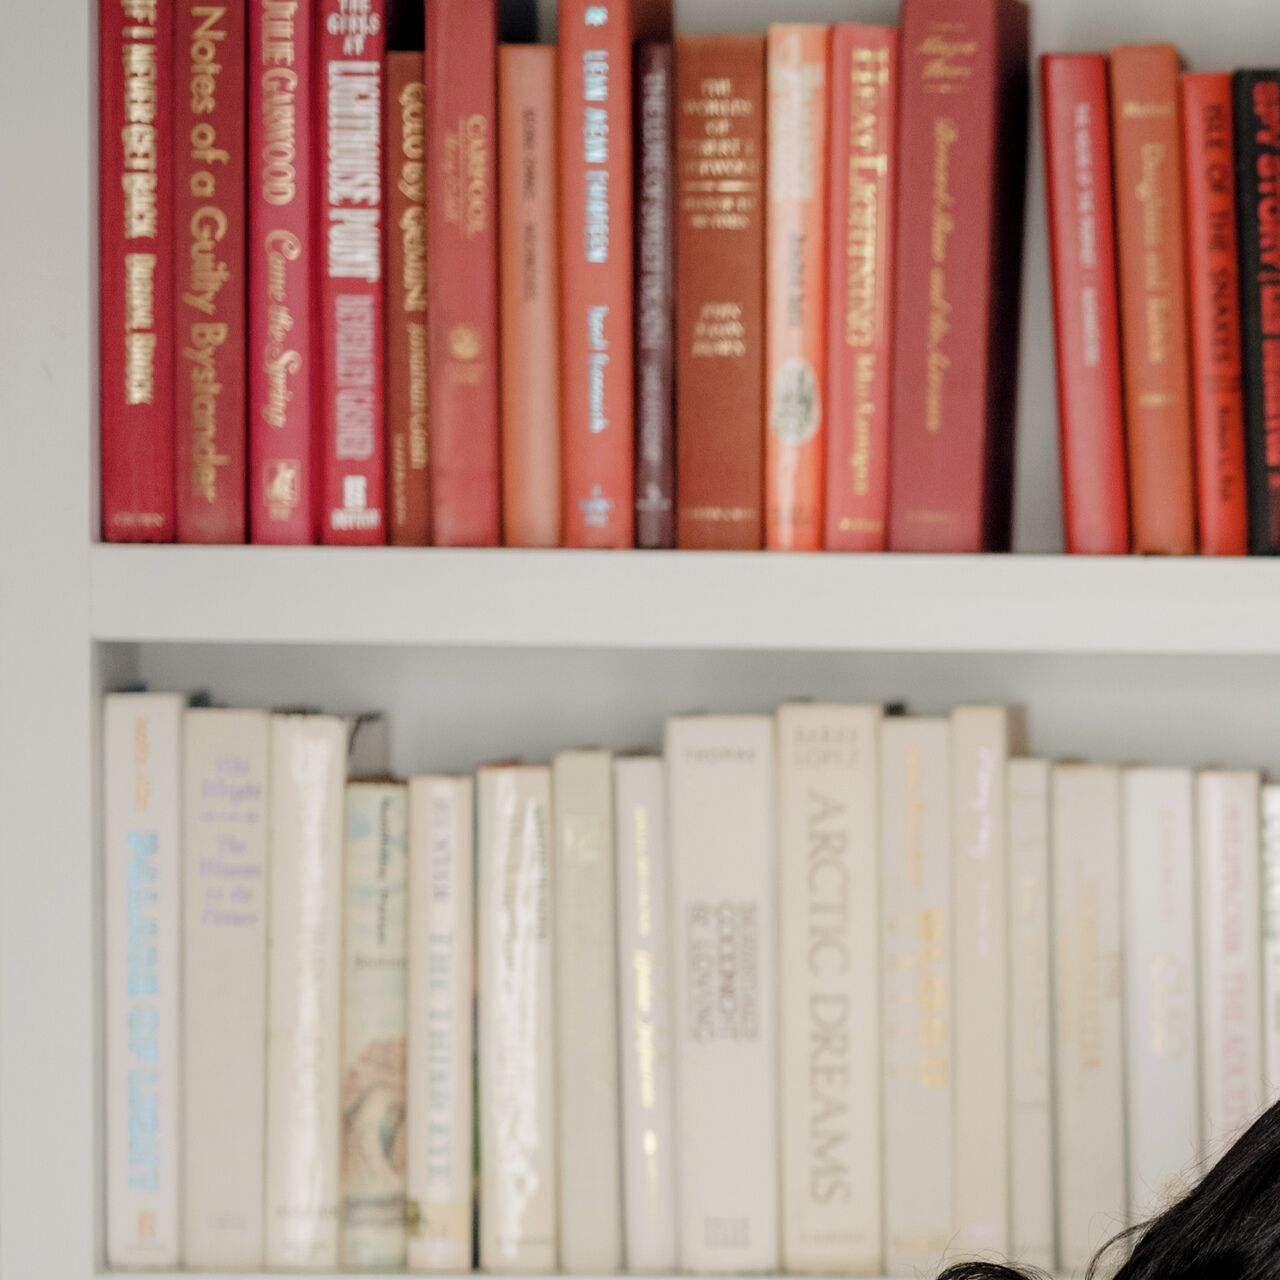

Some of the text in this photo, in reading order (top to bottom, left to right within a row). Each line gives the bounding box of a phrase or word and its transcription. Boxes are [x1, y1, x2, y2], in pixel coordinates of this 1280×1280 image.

[124, 44, 157, 122] NEVER
[262, 67, 301, 205] GARWOOD
[327, 60, 382, 283] LIGHTHOUSE POINT
[1207, 160, 1230, 197] OF
[183, 6, 230, 504] Notes of a Guilty Bystander
[846, 156, 889, 348] LIGHTNING
[261, 346, 303, 428] Spring
[127, 1004, 158, 1062] OF
[807, 791, 852, 1208] ARCTIC DREAMS
